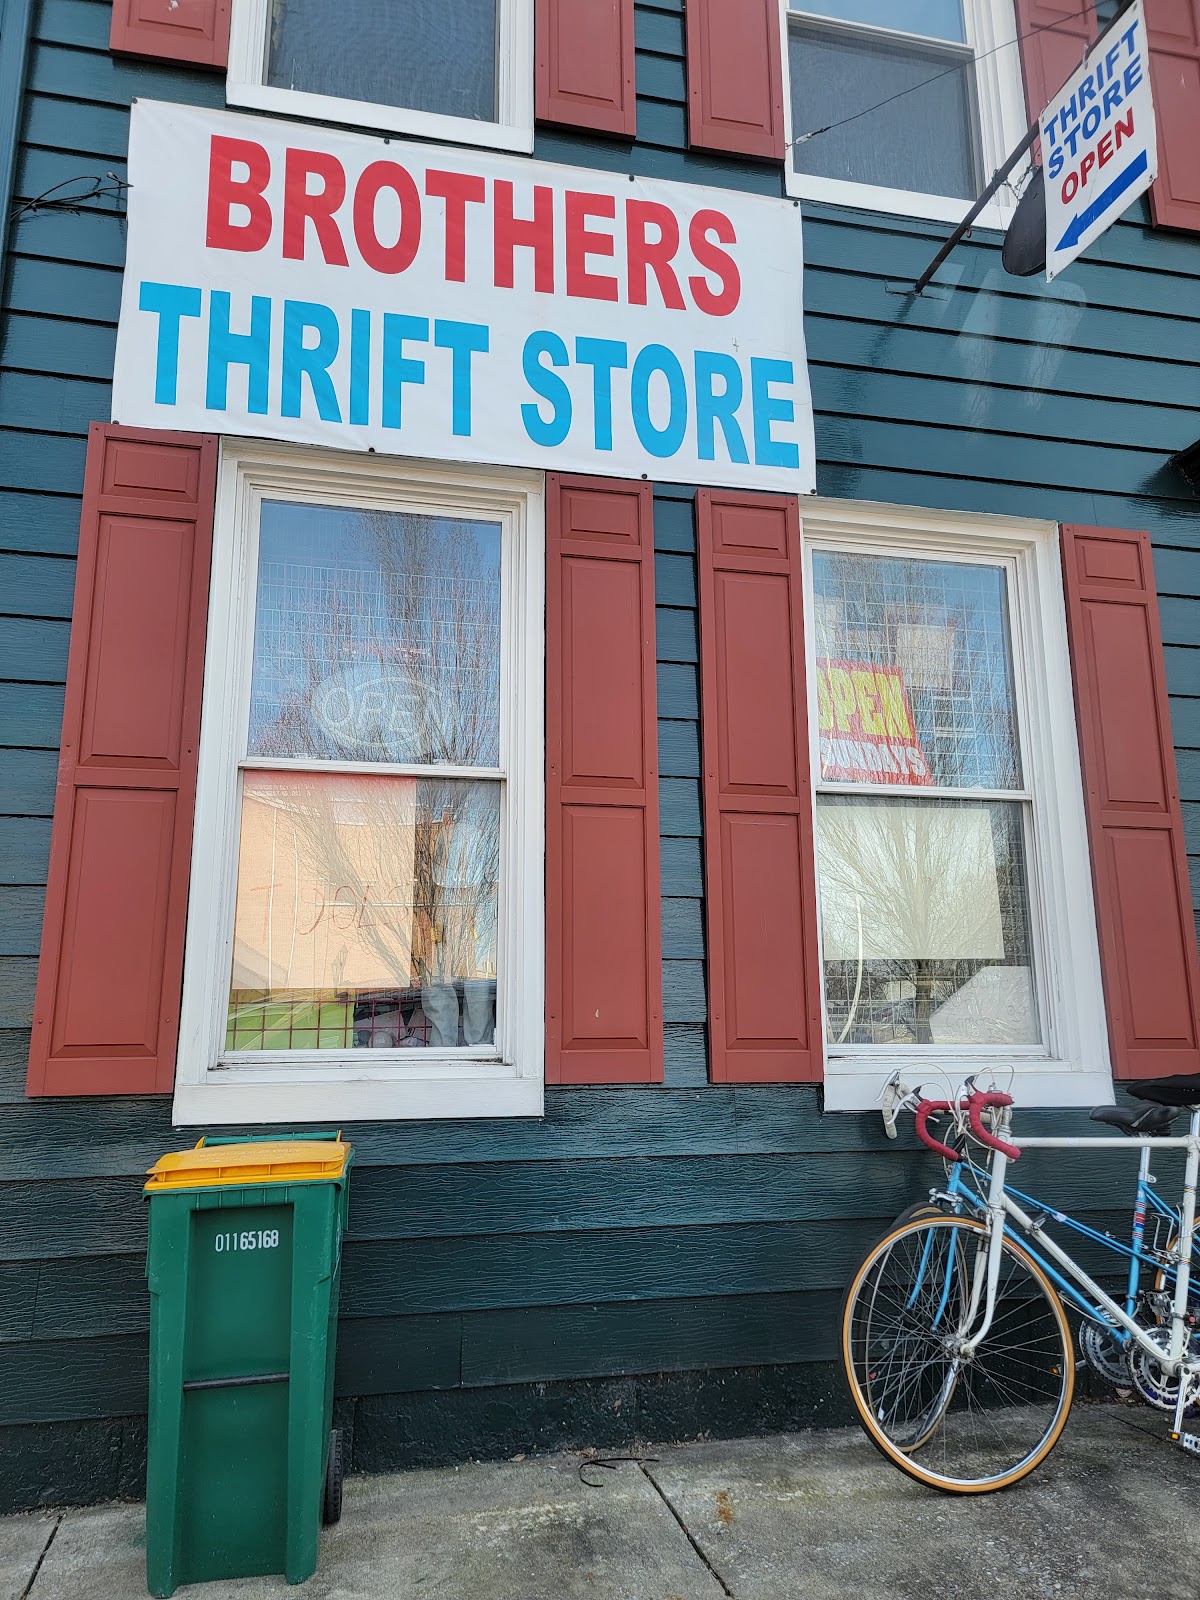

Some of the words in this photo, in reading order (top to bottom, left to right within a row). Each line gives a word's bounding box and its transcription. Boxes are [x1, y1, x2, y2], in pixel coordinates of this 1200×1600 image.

[1043, 18, 1139, 147] THRIFT
[1048, 53, 1143, 180] STORE
[1061, 106, 1135, 205] OPEN
[206, 135, 740, 316] BROTHERS
[139, 282, 488, 436] THRIFT
[521, 331, 799, 468] STORE
[819, 737, 926, 776] SUNDAYS
[215, 1229, 279, 1252] 01165168
